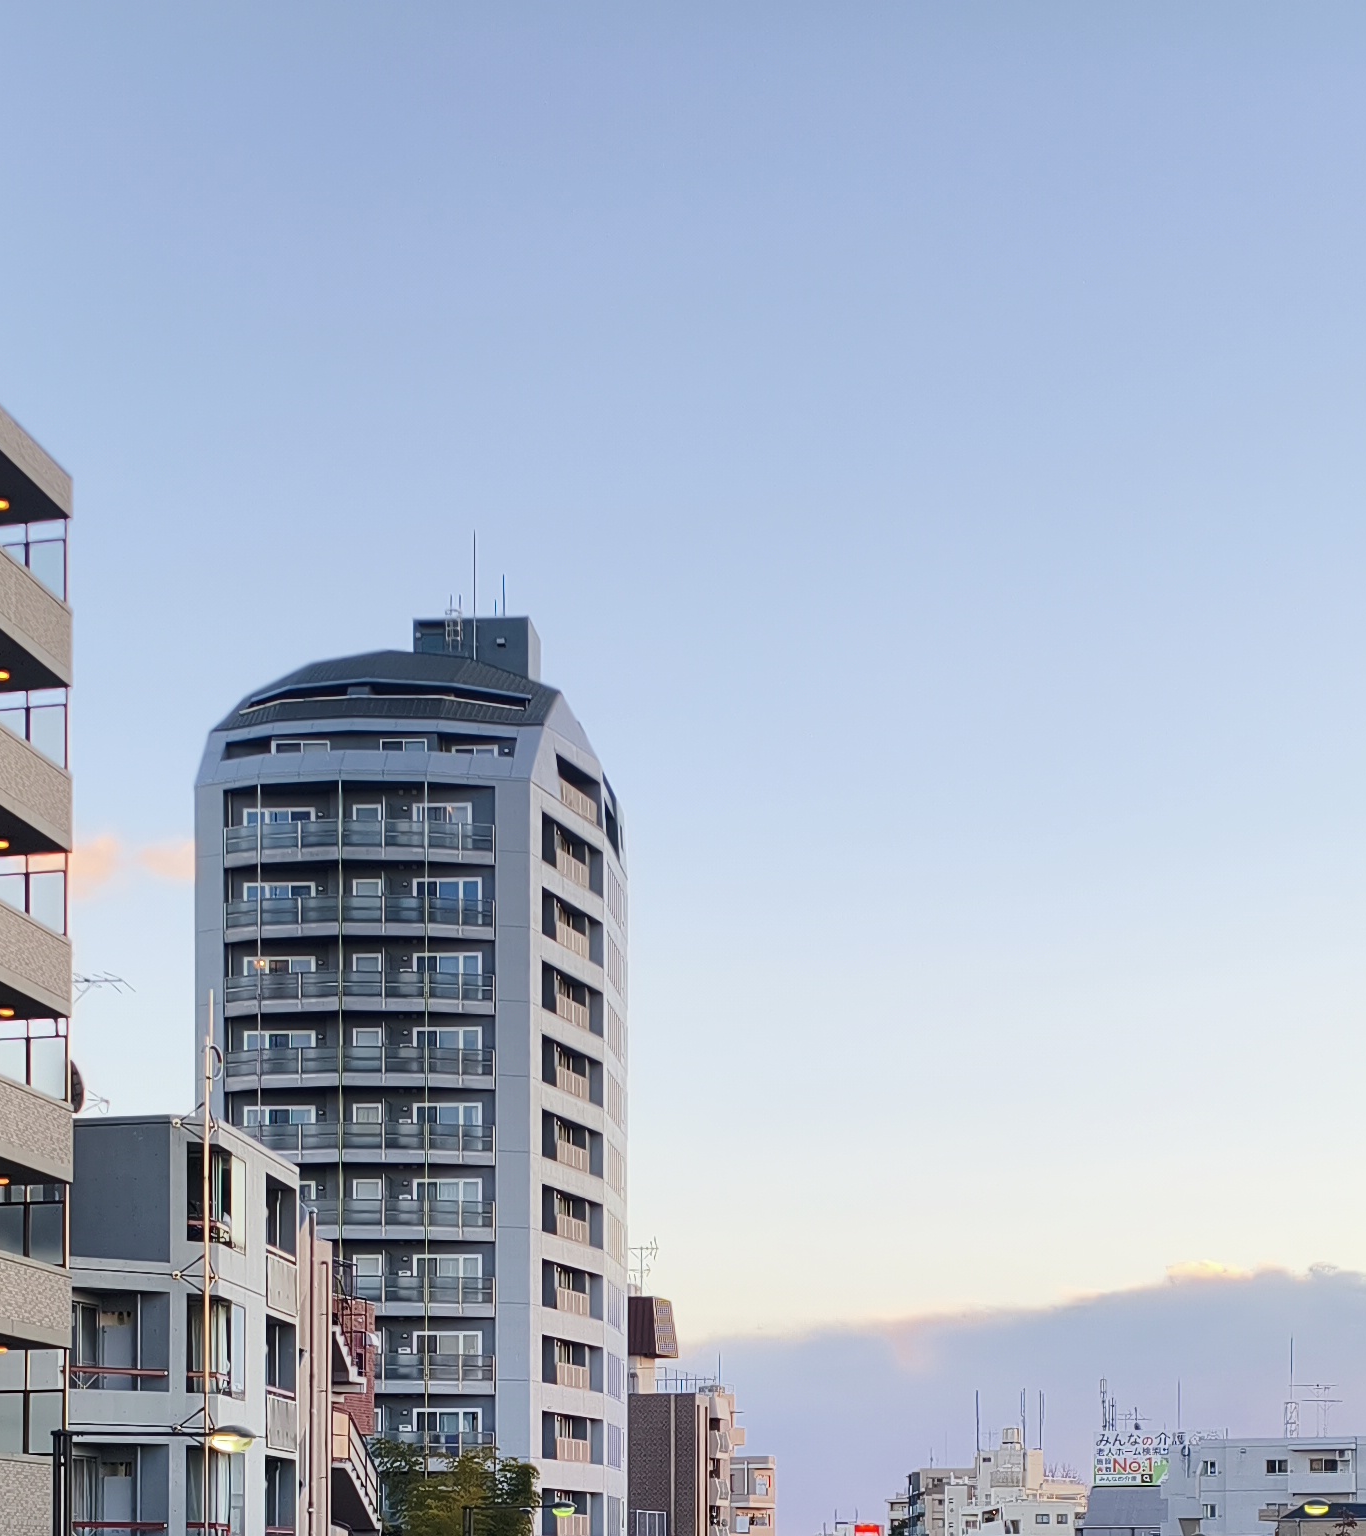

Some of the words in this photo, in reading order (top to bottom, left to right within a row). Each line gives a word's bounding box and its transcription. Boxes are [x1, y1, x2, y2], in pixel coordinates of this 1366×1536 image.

[1096, 1431, 1184, 1446] みんなの介護
